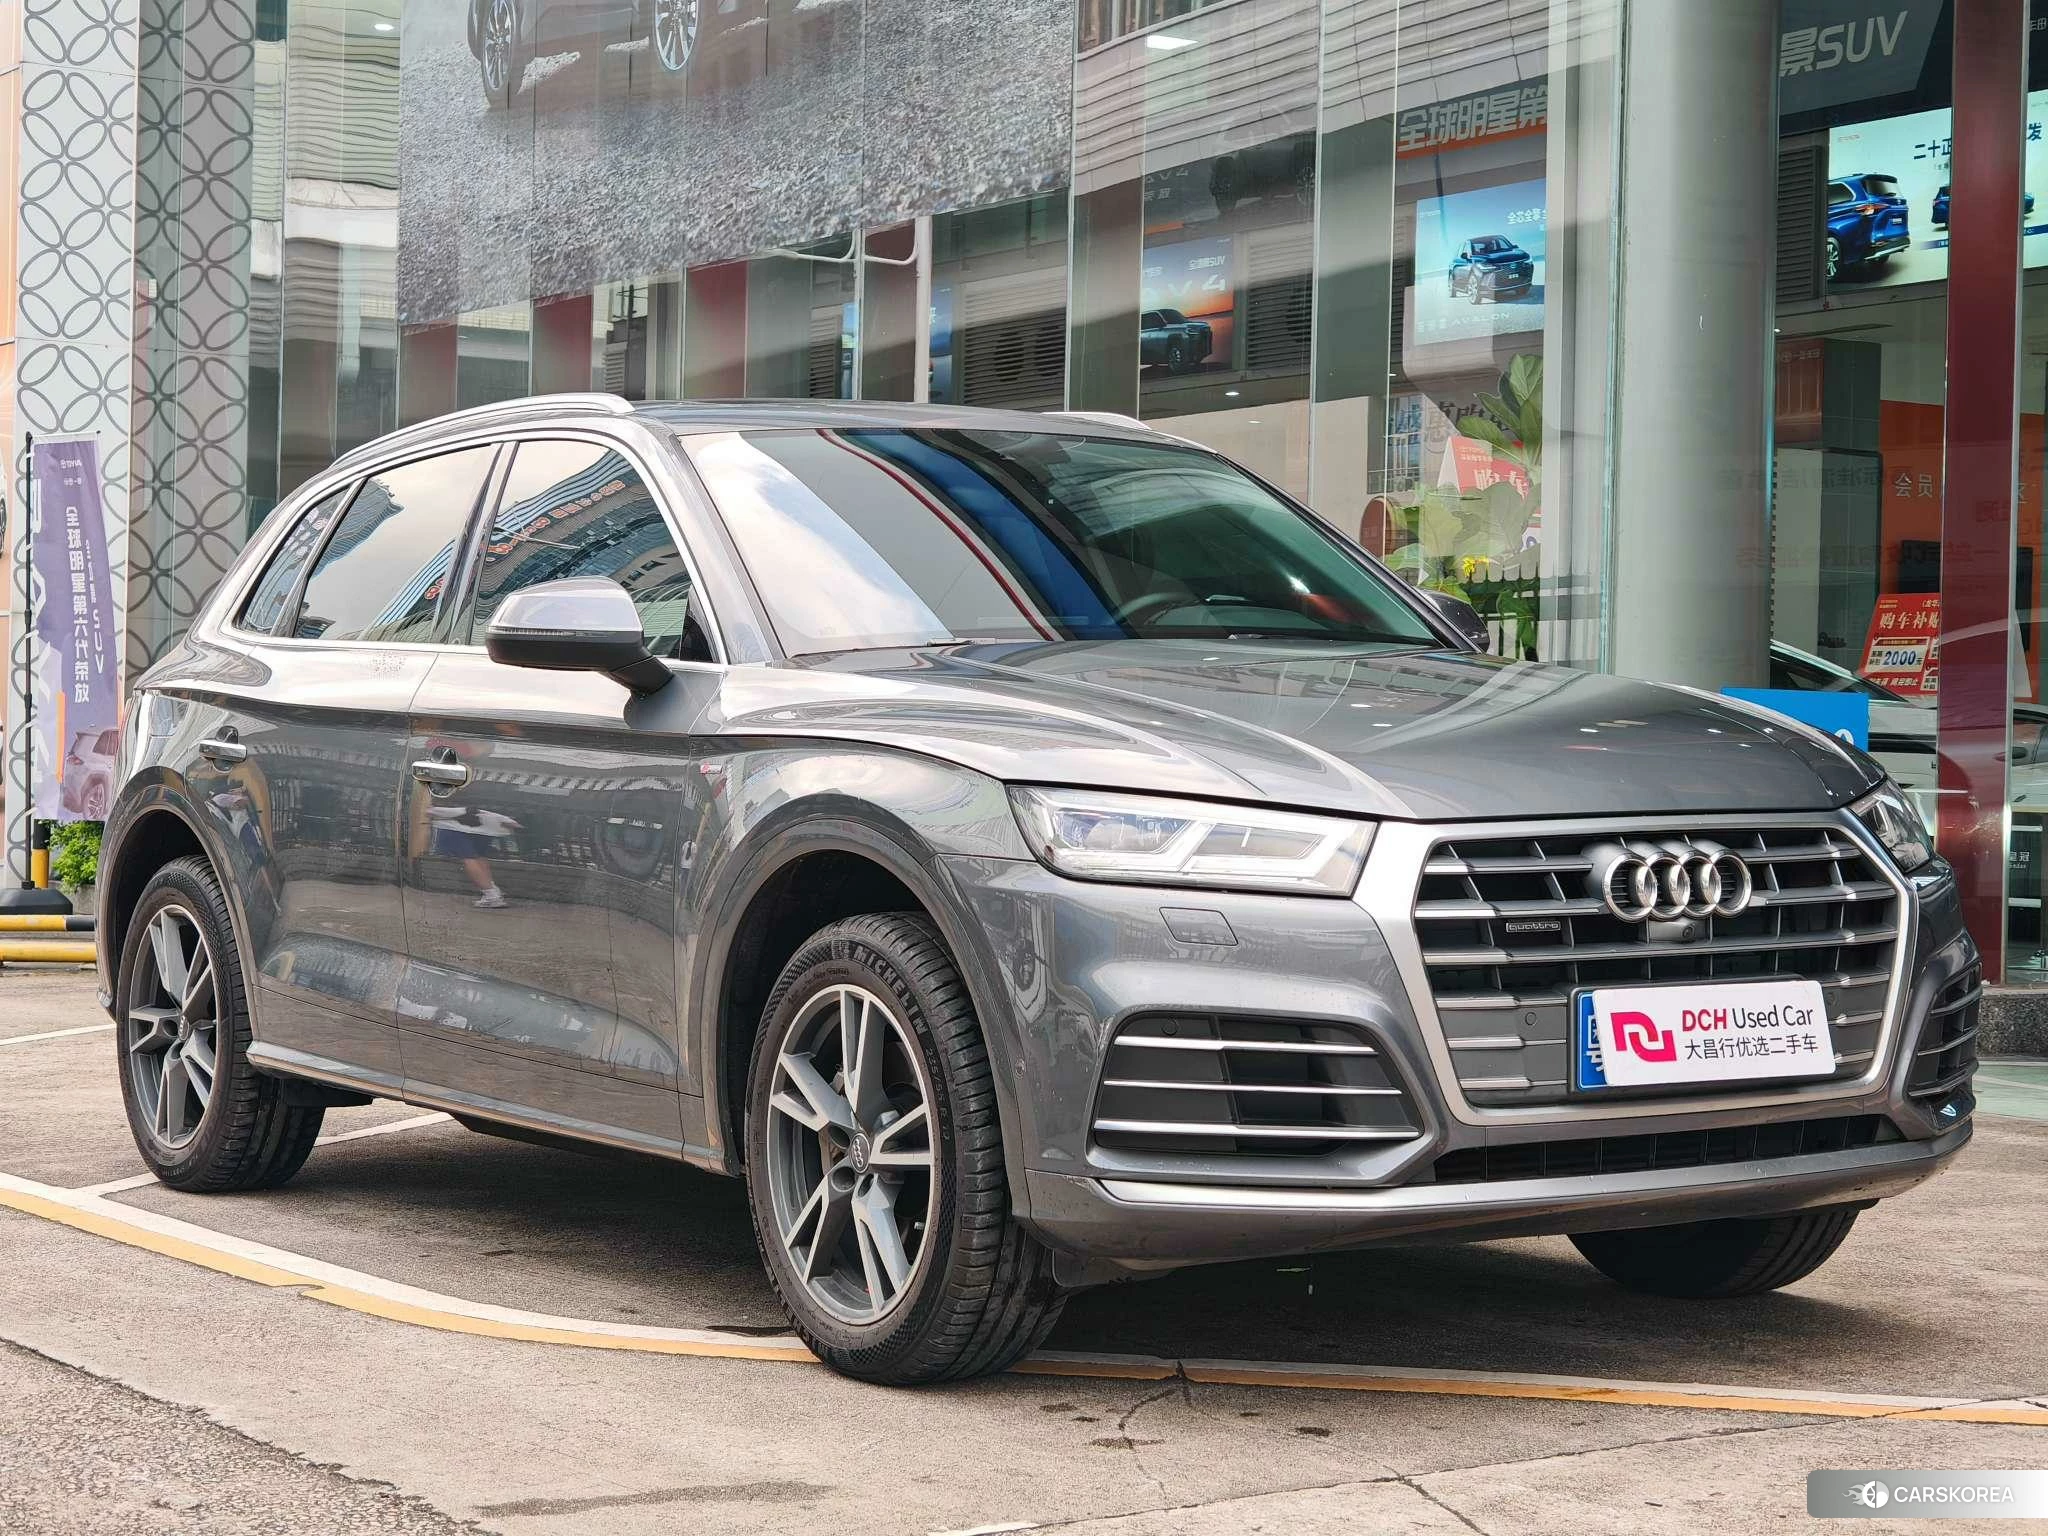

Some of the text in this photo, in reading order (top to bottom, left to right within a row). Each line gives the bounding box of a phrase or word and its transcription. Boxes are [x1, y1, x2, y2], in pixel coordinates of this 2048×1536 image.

[1397, 84, 1548, 152] 全球明星第
[66, 506, 89, 703] 全球明星第六代荣放
[1508, 921, 1559, 931] quattro
[1682, 1004, 1814, 1032] DCH Used Car
[1684, 1033, 1819, 1061] 大昌行优选二手车
